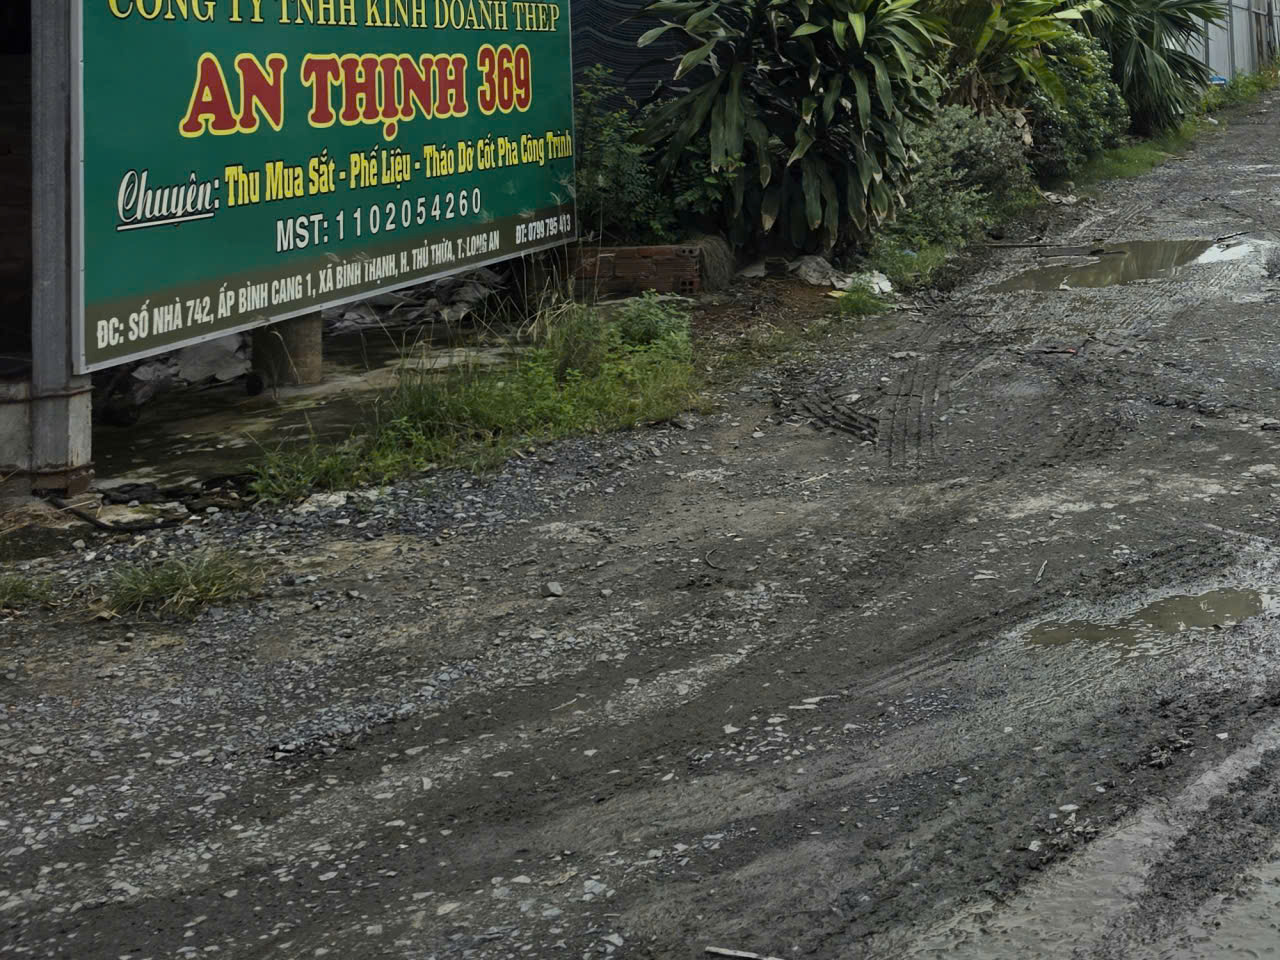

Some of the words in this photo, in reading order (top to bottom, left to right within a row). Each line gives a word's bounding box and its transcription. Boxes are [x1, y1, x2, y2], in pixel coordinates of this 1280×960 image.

[179, 51, 288, 138] AN
[300, 52, 468, 142] THỊNH
[477, 43, 532, 116] 369
[117, 169, 220, 224] Chuyên:
[225, 165, 260, 207] Thu
[265, 160, 304, 202] Mua
[308, 148, 336, 196] Sắt
[349, 144, 379, 189] Phế
[381, 147, 411, 189] Liệu
[423, 143, 455, 178] Tháo
[476, 133, 496, 171] Cốt
[497, 136, 519, 168] Pha
[520, 133, 545, 167] Công
[546, 129, 574, 160] Trình
[276, 213, 329, 253] MST:
[515, 221, 528, 244] ĐT:
[528, 219, 545, 242] 0799
[545, 216, 559, 237] 795
[96, 317, 125, 349] ĐC:
[128, 298, 151, 340] SỐ
[153, 297, 183, 335] NHÀ
[186, 296, 214, 326] 742,
[217, 282, 236, 319] ẤP
[238, 281, 269, 314] BÌNH
[271, 274, 303, 305] CANG
[306, 273, 317, 298] 1,
[318, 263, 335, 294] XÃ
[335, 261, 362, 288] BÌNH
[363, 253, 399, 286] THẠNH,
[400, 251, 410, 274] H.
[411, 240, 429, 271] THỦ
[431, 238, 456, 266] THỪA,
[456, 238, 465, 259] T.
[466, 232, 488, 257] LONG
[488, 229, 501, 252] AN
